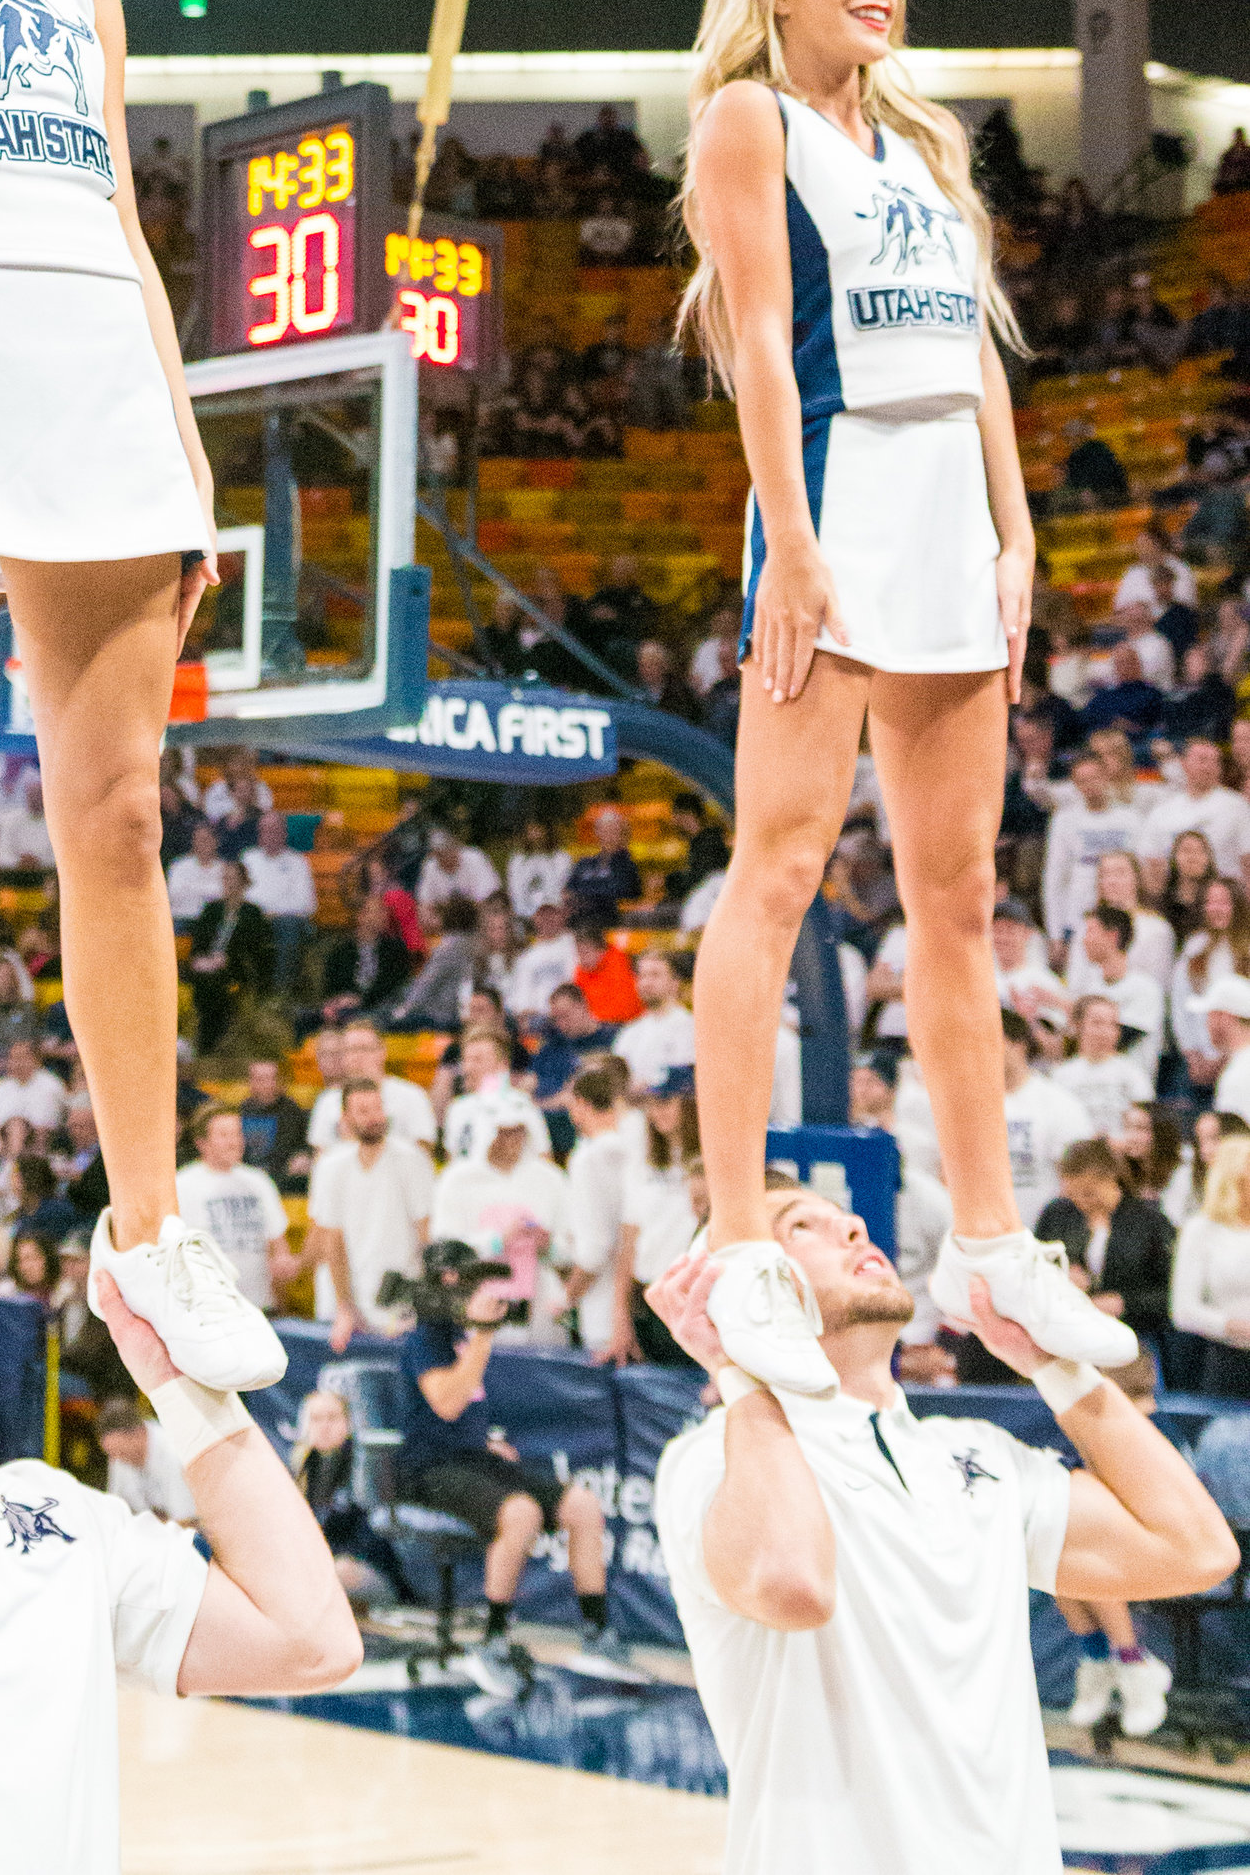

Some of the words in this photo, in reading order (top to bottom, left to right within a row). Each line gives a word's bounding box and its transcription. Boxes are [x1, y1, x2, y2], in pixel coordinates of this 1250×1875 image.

[247, 210, 340, 346] 30
[847, 286, 935, 331] UTAH
[397, 288, 461, 364] 30
[497, 703, 611, 760] FIRST
